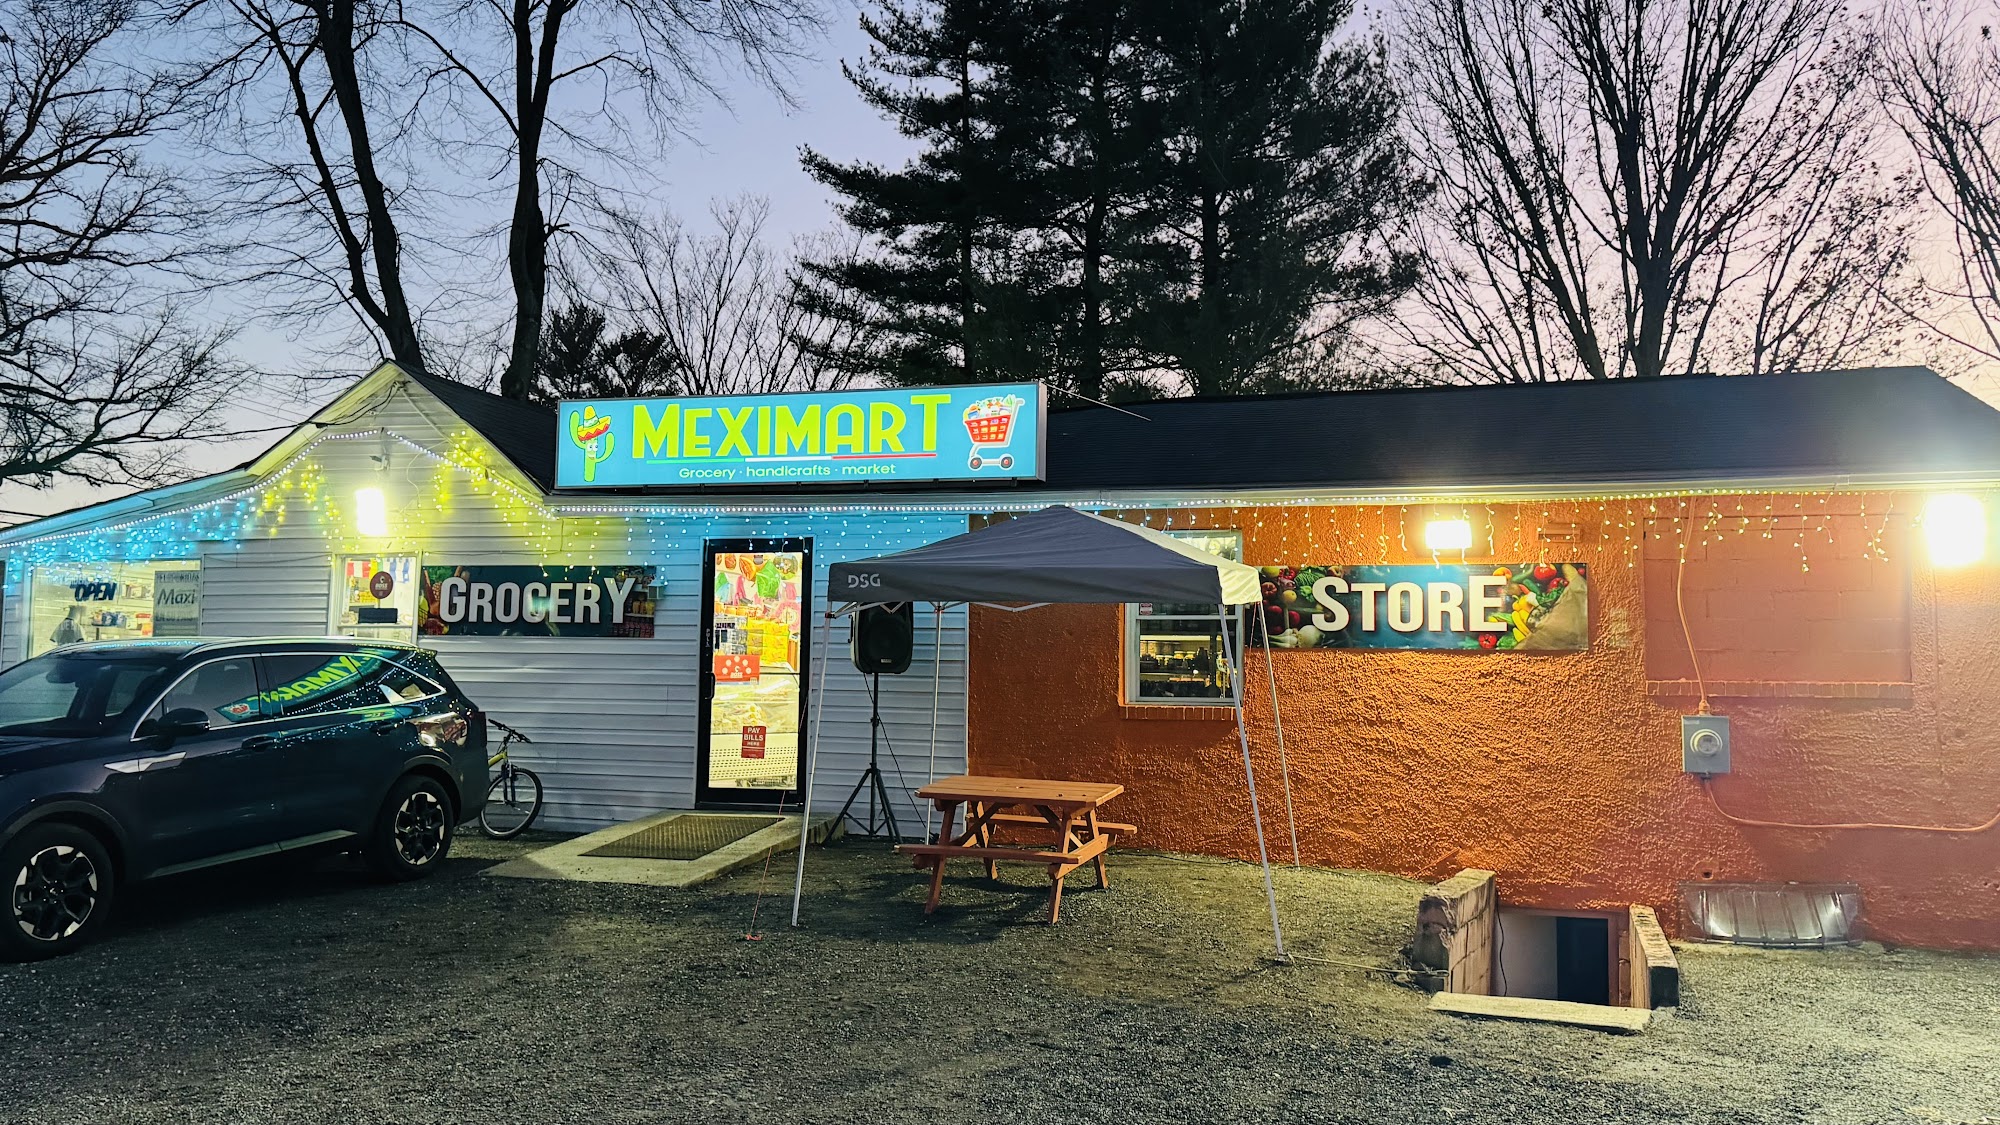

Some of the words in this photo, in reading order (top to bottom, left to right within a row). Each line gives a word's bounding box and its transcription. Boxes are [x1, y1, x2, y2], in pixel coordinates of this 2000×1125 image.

[632, 394, 951, 458] MEXIMART
[679, 467, 736, 480] Grocery
[746, 464, 831, 477] handicrafts
[842, 464, 896, 475] market
[848, 573, 881, 588] DSG
[74, 582, 117, 602] OPEN
[157, 588, 196, 605] Maxi
[439, 577, 636, 624] GROCERY
[1312, 575, 1508, 632] STORE
